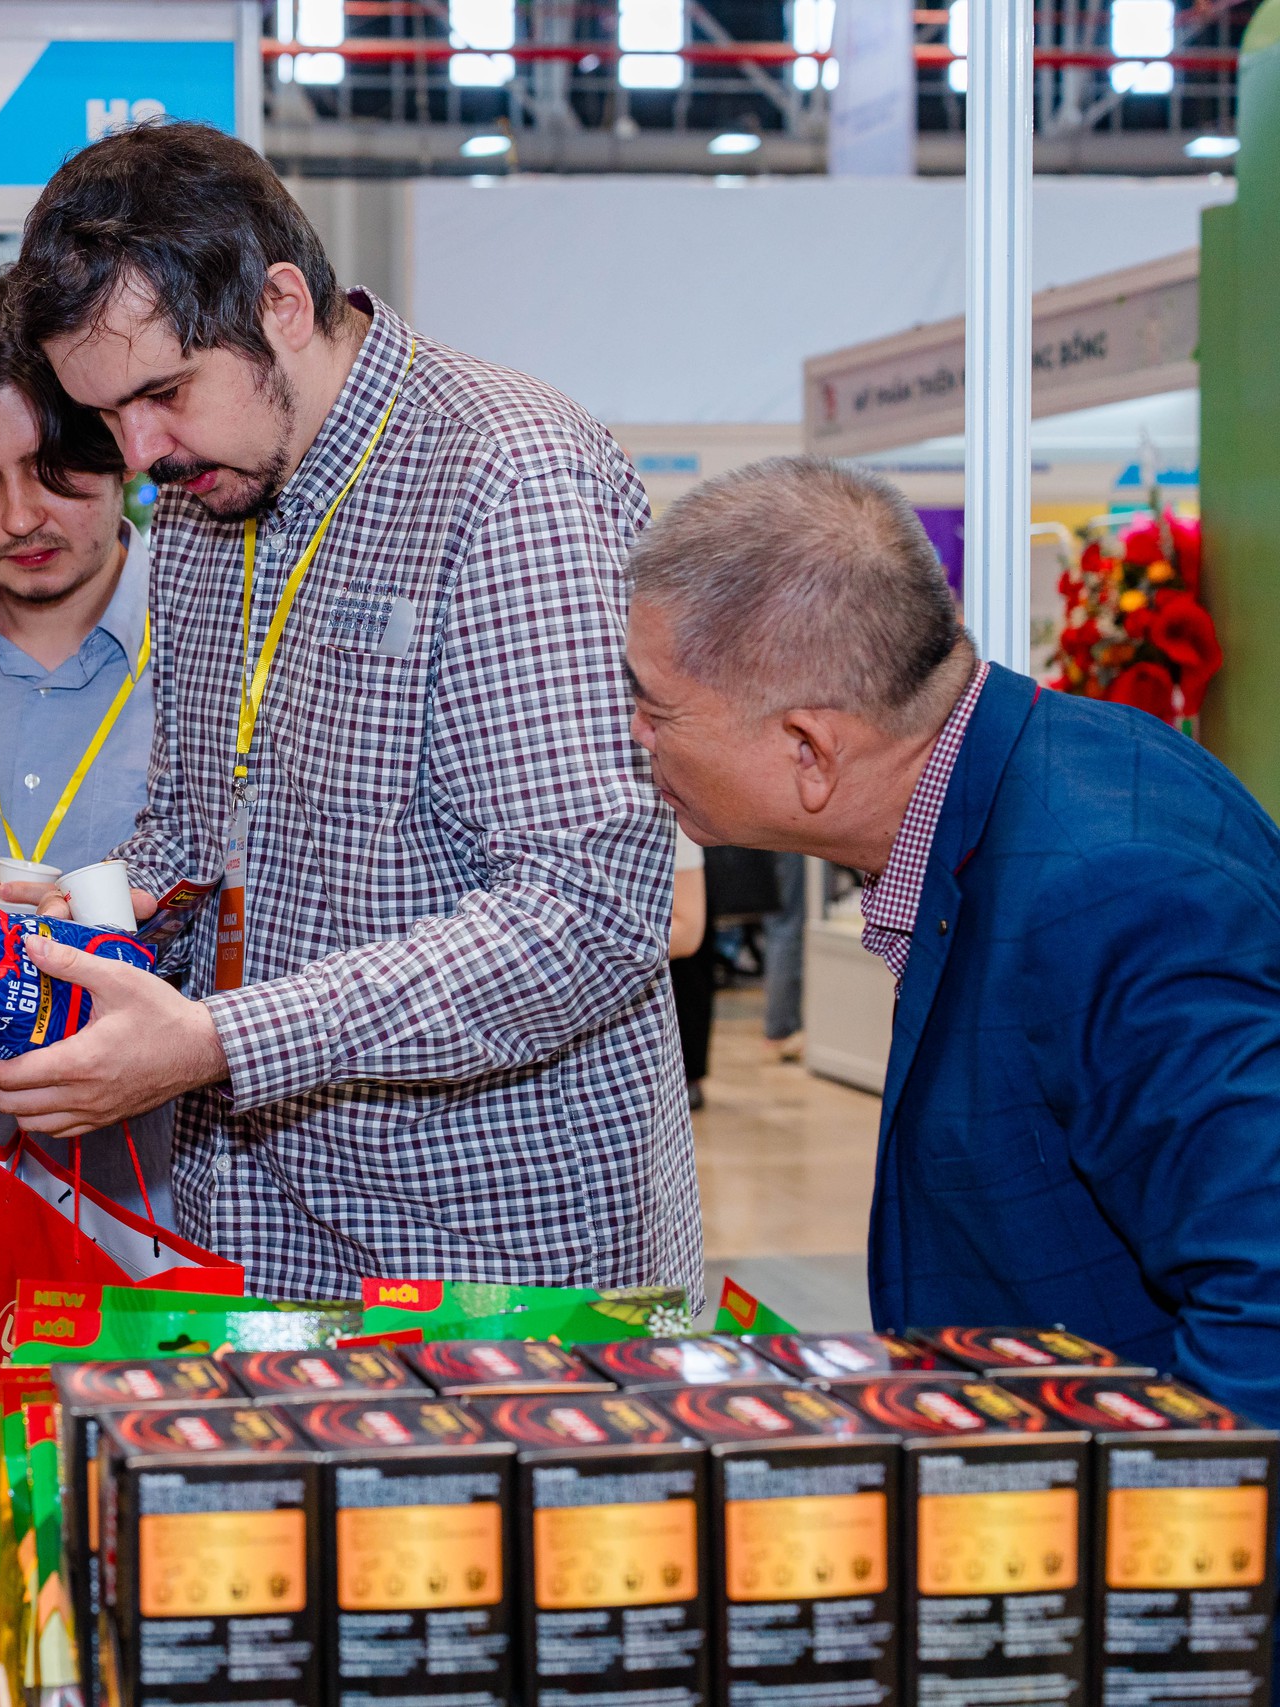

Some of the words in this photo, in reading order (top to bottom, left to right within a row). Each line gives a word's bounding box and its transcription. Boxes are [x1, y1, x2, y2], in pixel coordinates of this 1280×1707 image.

[5, 979, 21, 1012] PHÊ
[18, 982, 40, 1014] GU
[36, 984, 50, 1034] WEASEL
[33, 1290, 87, 1308] NEW
